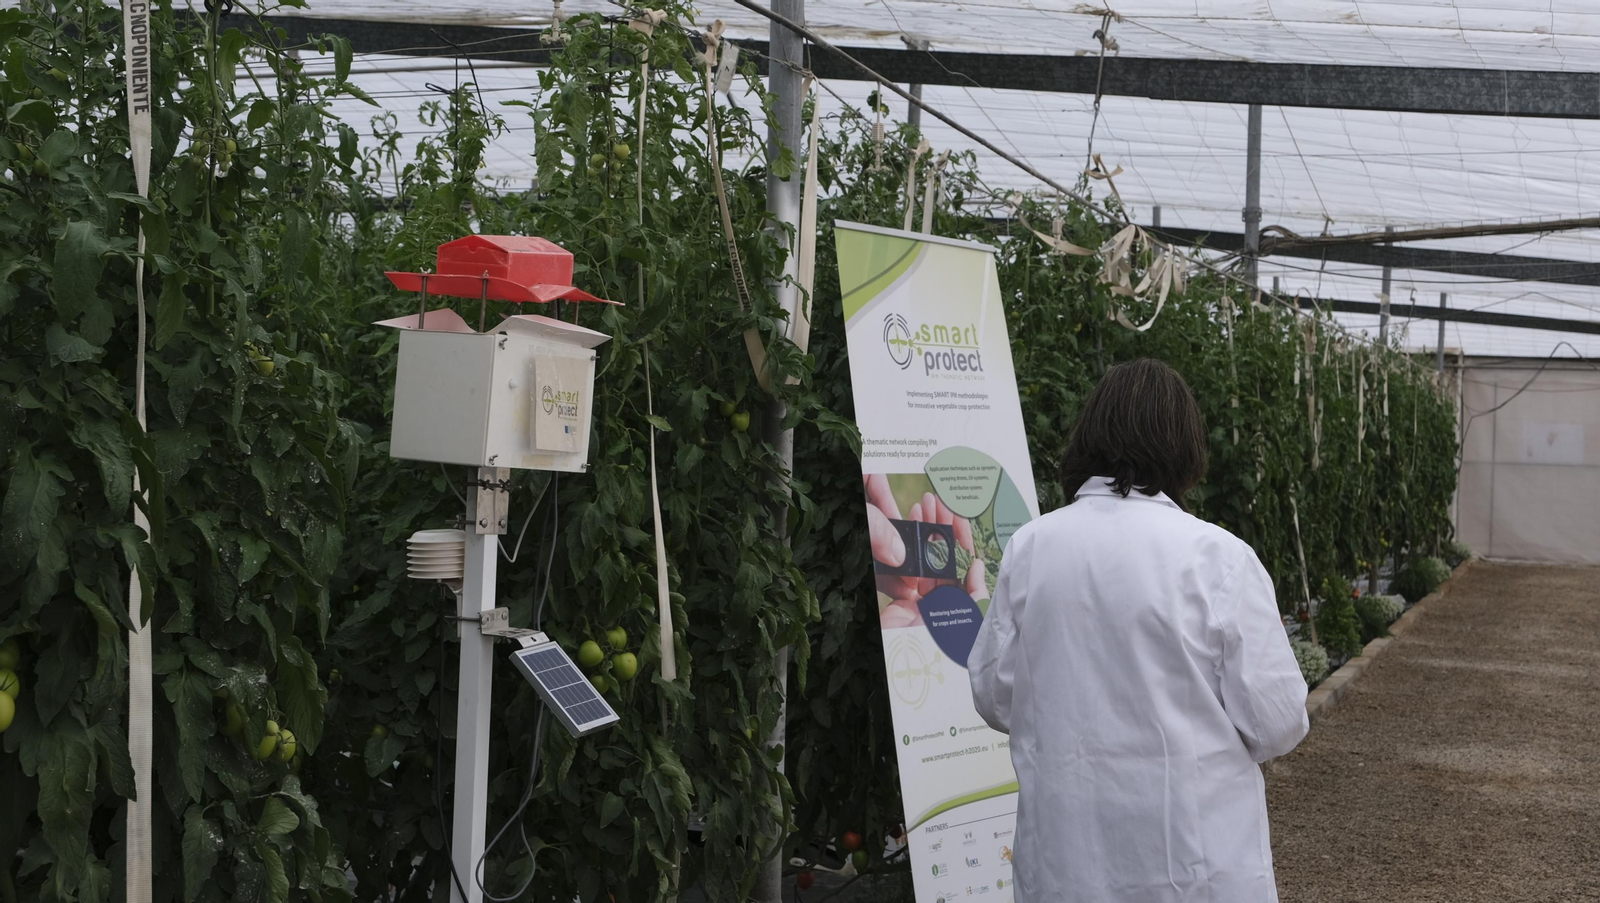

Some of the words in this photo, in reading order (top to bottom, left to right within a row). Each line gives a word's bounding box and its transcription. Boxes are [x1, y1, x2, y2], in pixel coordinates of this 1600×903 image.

[130, 0, 149, 115] CNOPONIENTE
[729, 238, 751, 310] TECNOPONIEN
[921, 323, 978, 345] smart
[924, 348, 984, 376] protect
[558, 390, 579, 402] smart
[906, 390, 934, 399] Implementing
[957, 392, 989, 400] methodologies
[914, 401, 935, 409] innovative
[936, 402, 957, 410] vegetable
[908, 438, 928, 447] compiling
[887, 450, 899, 458] ready
[907, 450, 924, 458] practice
[921, 746, 988, 763] www.smartprotect-h2020.eu
[925, 823, 949, 834] PARTNERS
